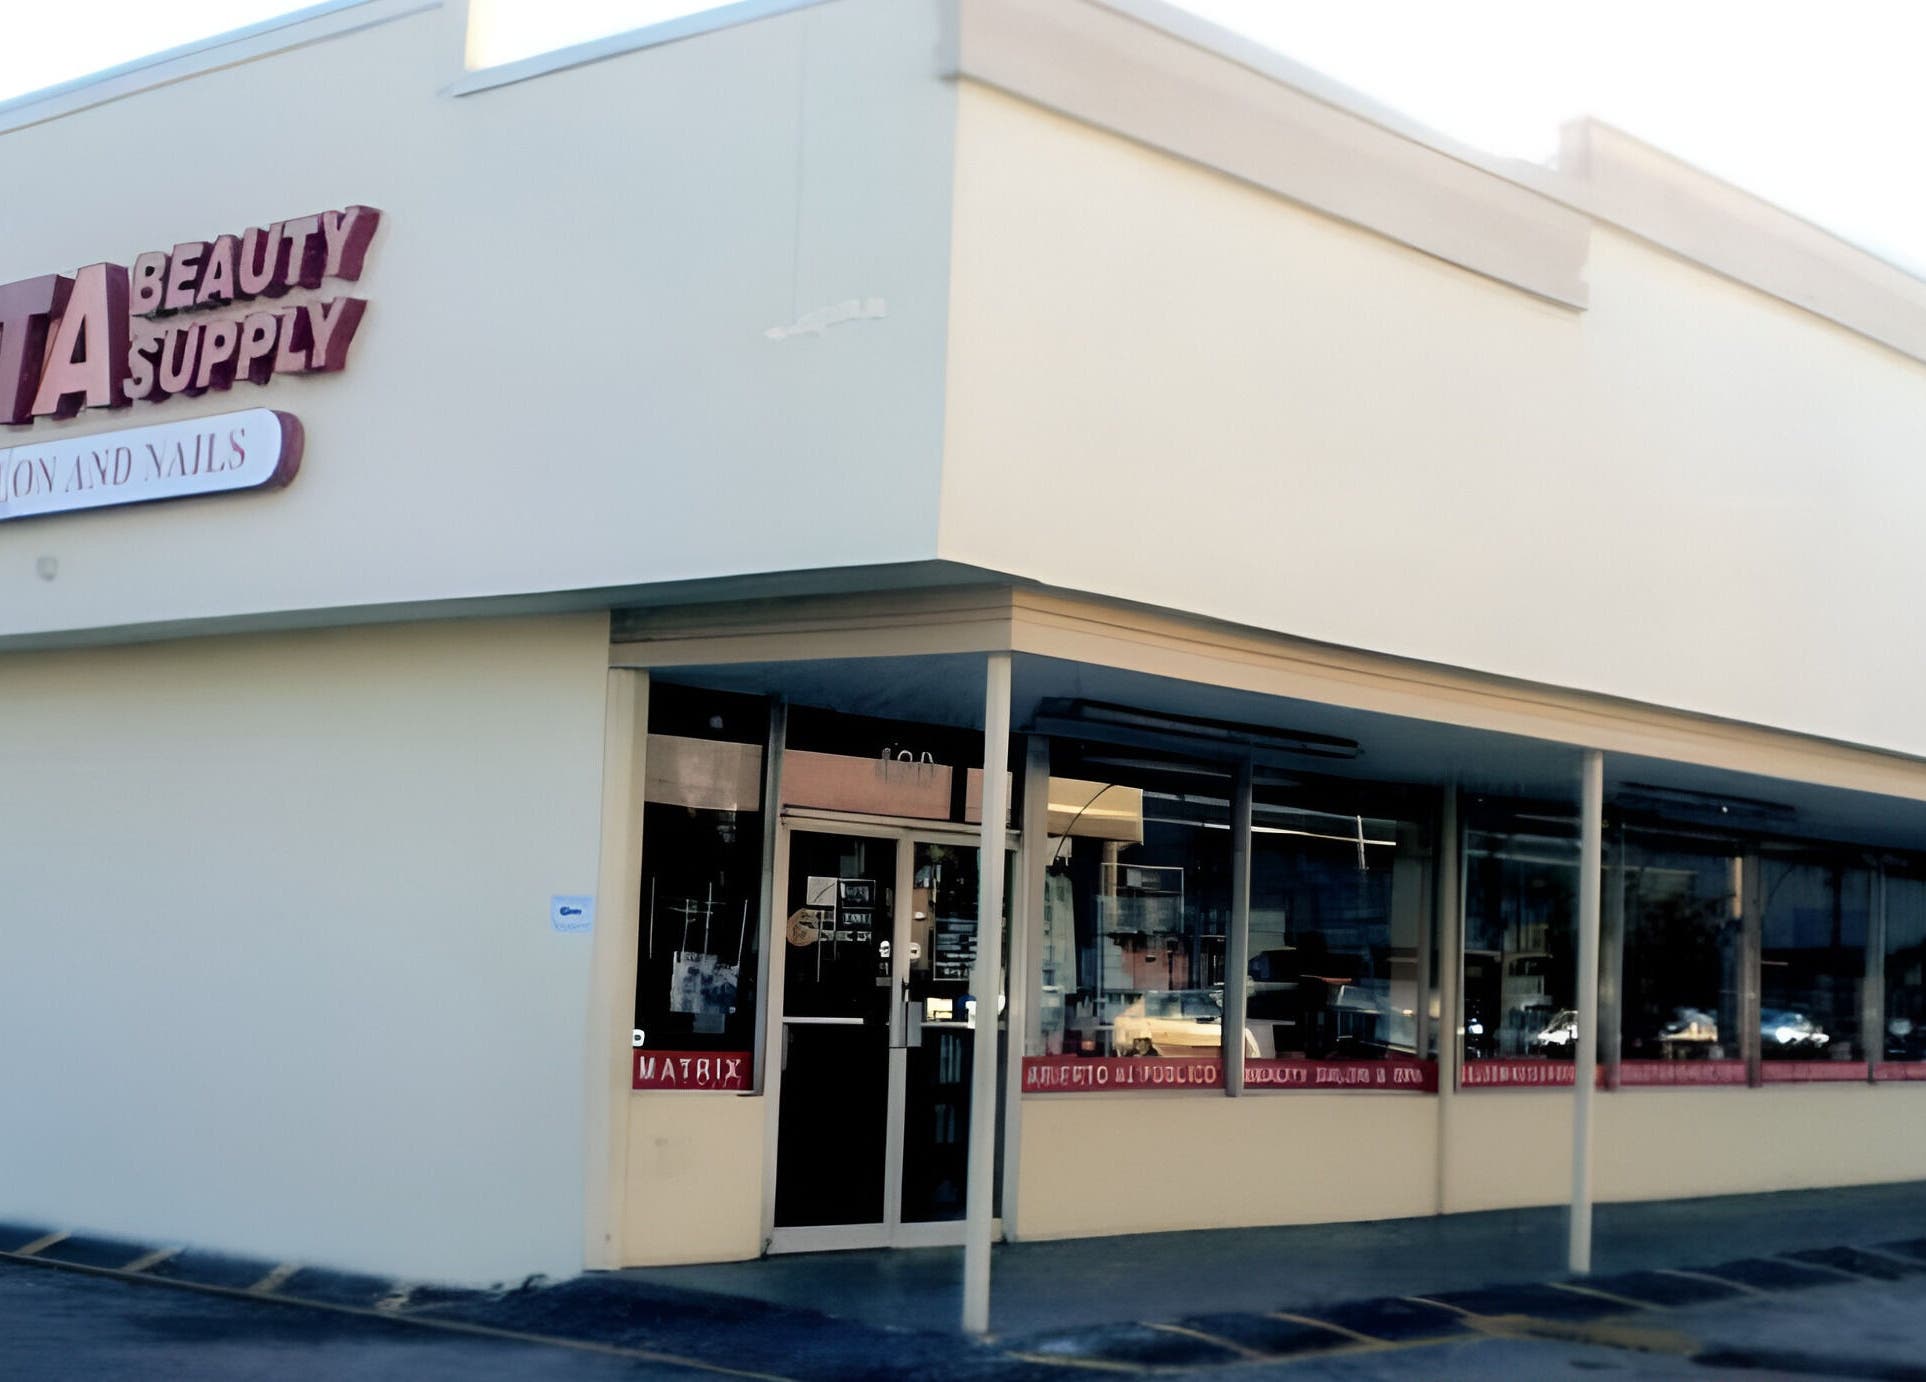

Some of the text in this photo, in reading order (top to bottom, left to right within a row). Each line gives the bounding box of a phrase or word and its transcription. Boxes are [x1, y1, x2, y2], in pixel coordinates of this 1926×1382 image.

[131, 205, 380, 316] BEAUTY
[123, 297, 366, 402] SUPPLY
[65, 446, 132, 494] AND
[145, 427, 247, 482] NAILS
[638, 1055, 742, 1085] MATRIX
